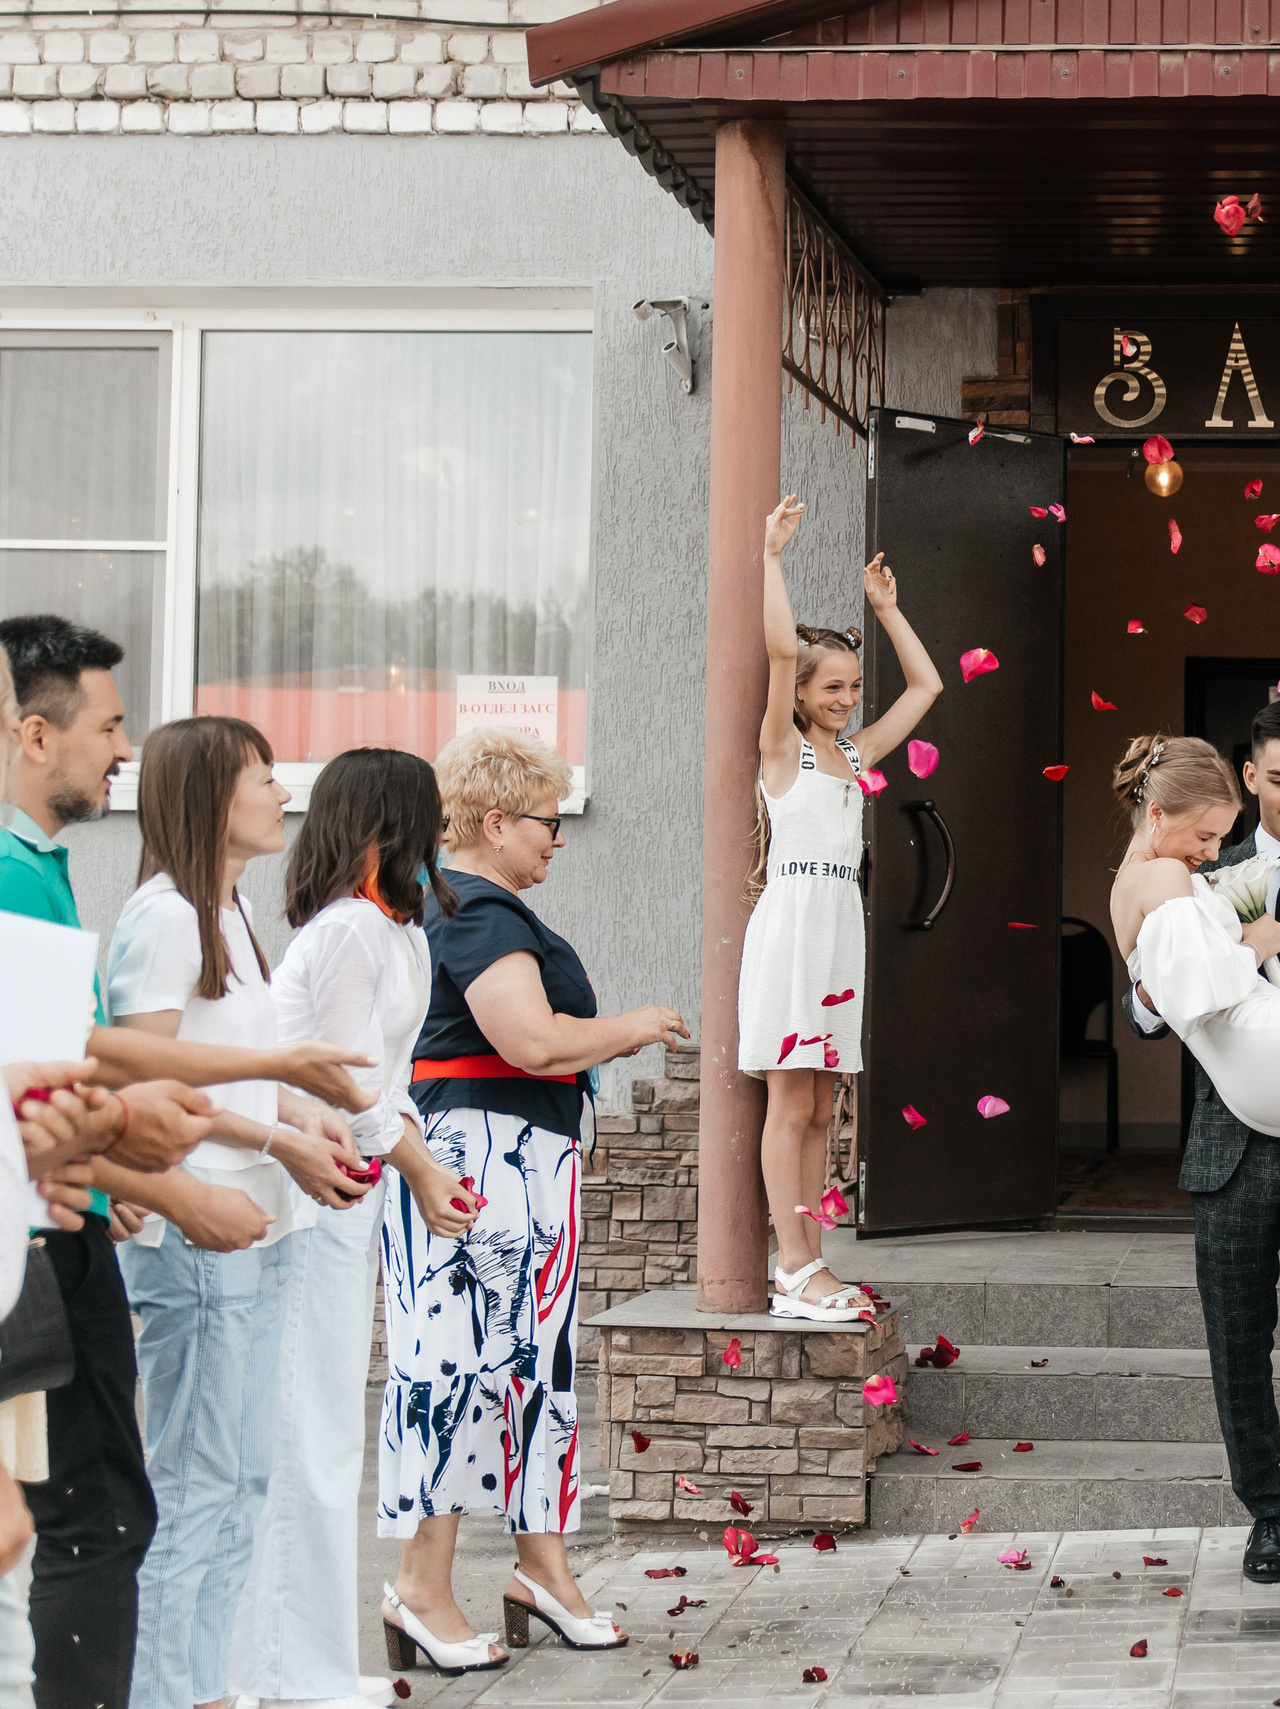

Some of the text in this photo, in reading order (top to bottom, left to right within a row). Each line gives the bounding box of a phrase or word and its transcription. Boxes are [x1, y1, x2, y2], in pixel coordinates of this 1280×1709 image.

[488, 681, 525, 693] ВХОД
[459, 703, 555, 715] В ОТДЕЛ ЗАГС
[781, 861, 818, 876] LOVE
